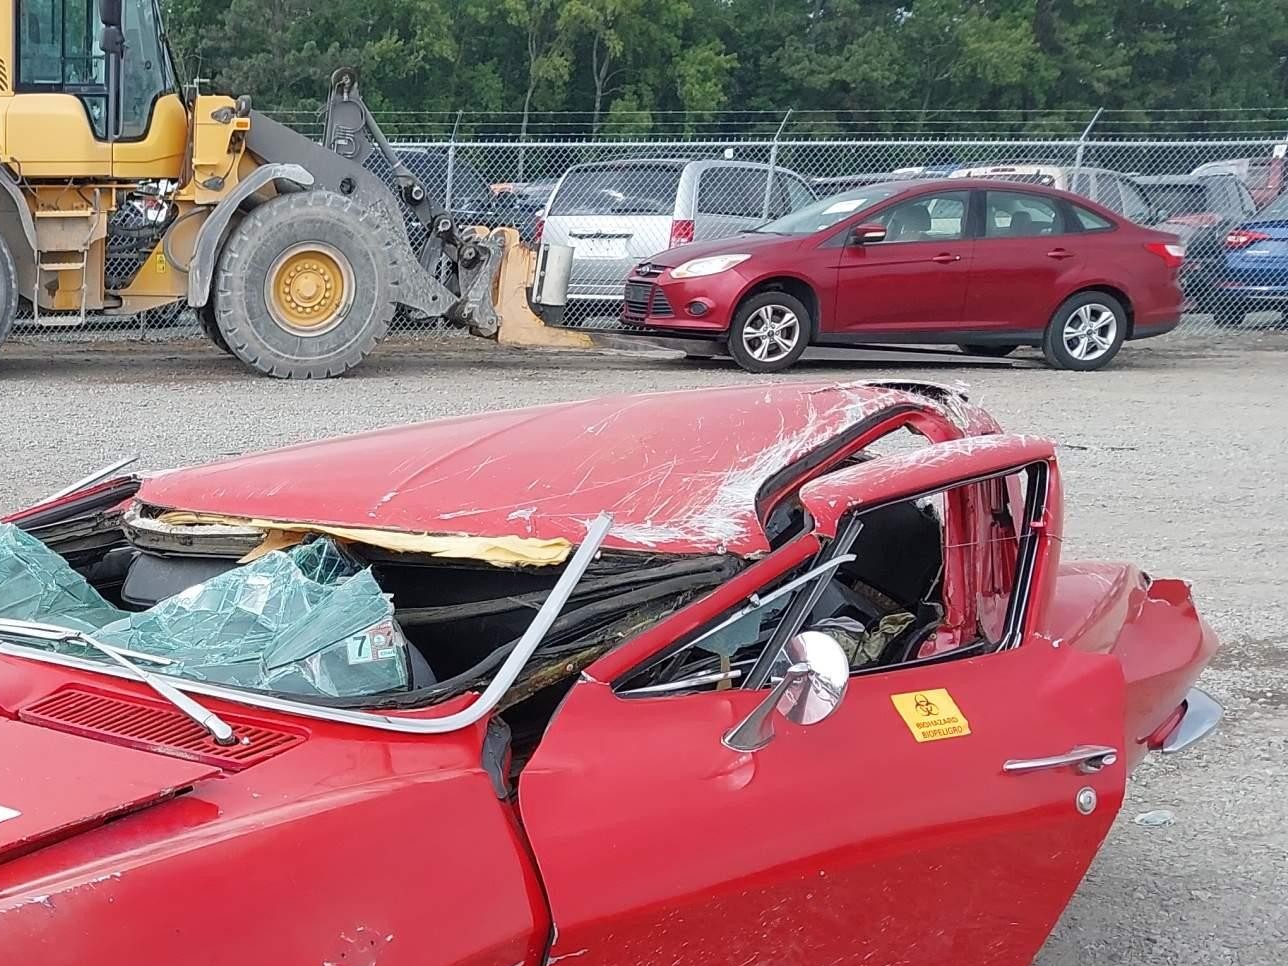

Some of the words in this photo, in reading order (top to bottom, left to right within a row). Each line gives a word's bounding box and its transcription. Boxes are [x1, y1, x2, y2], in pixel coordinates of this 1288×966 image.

[352, 635, 367, 657] 7
[915, 716, 959, 729] BIOHAZARD
[921, 725, 963, 739] BIOPELIGRO
